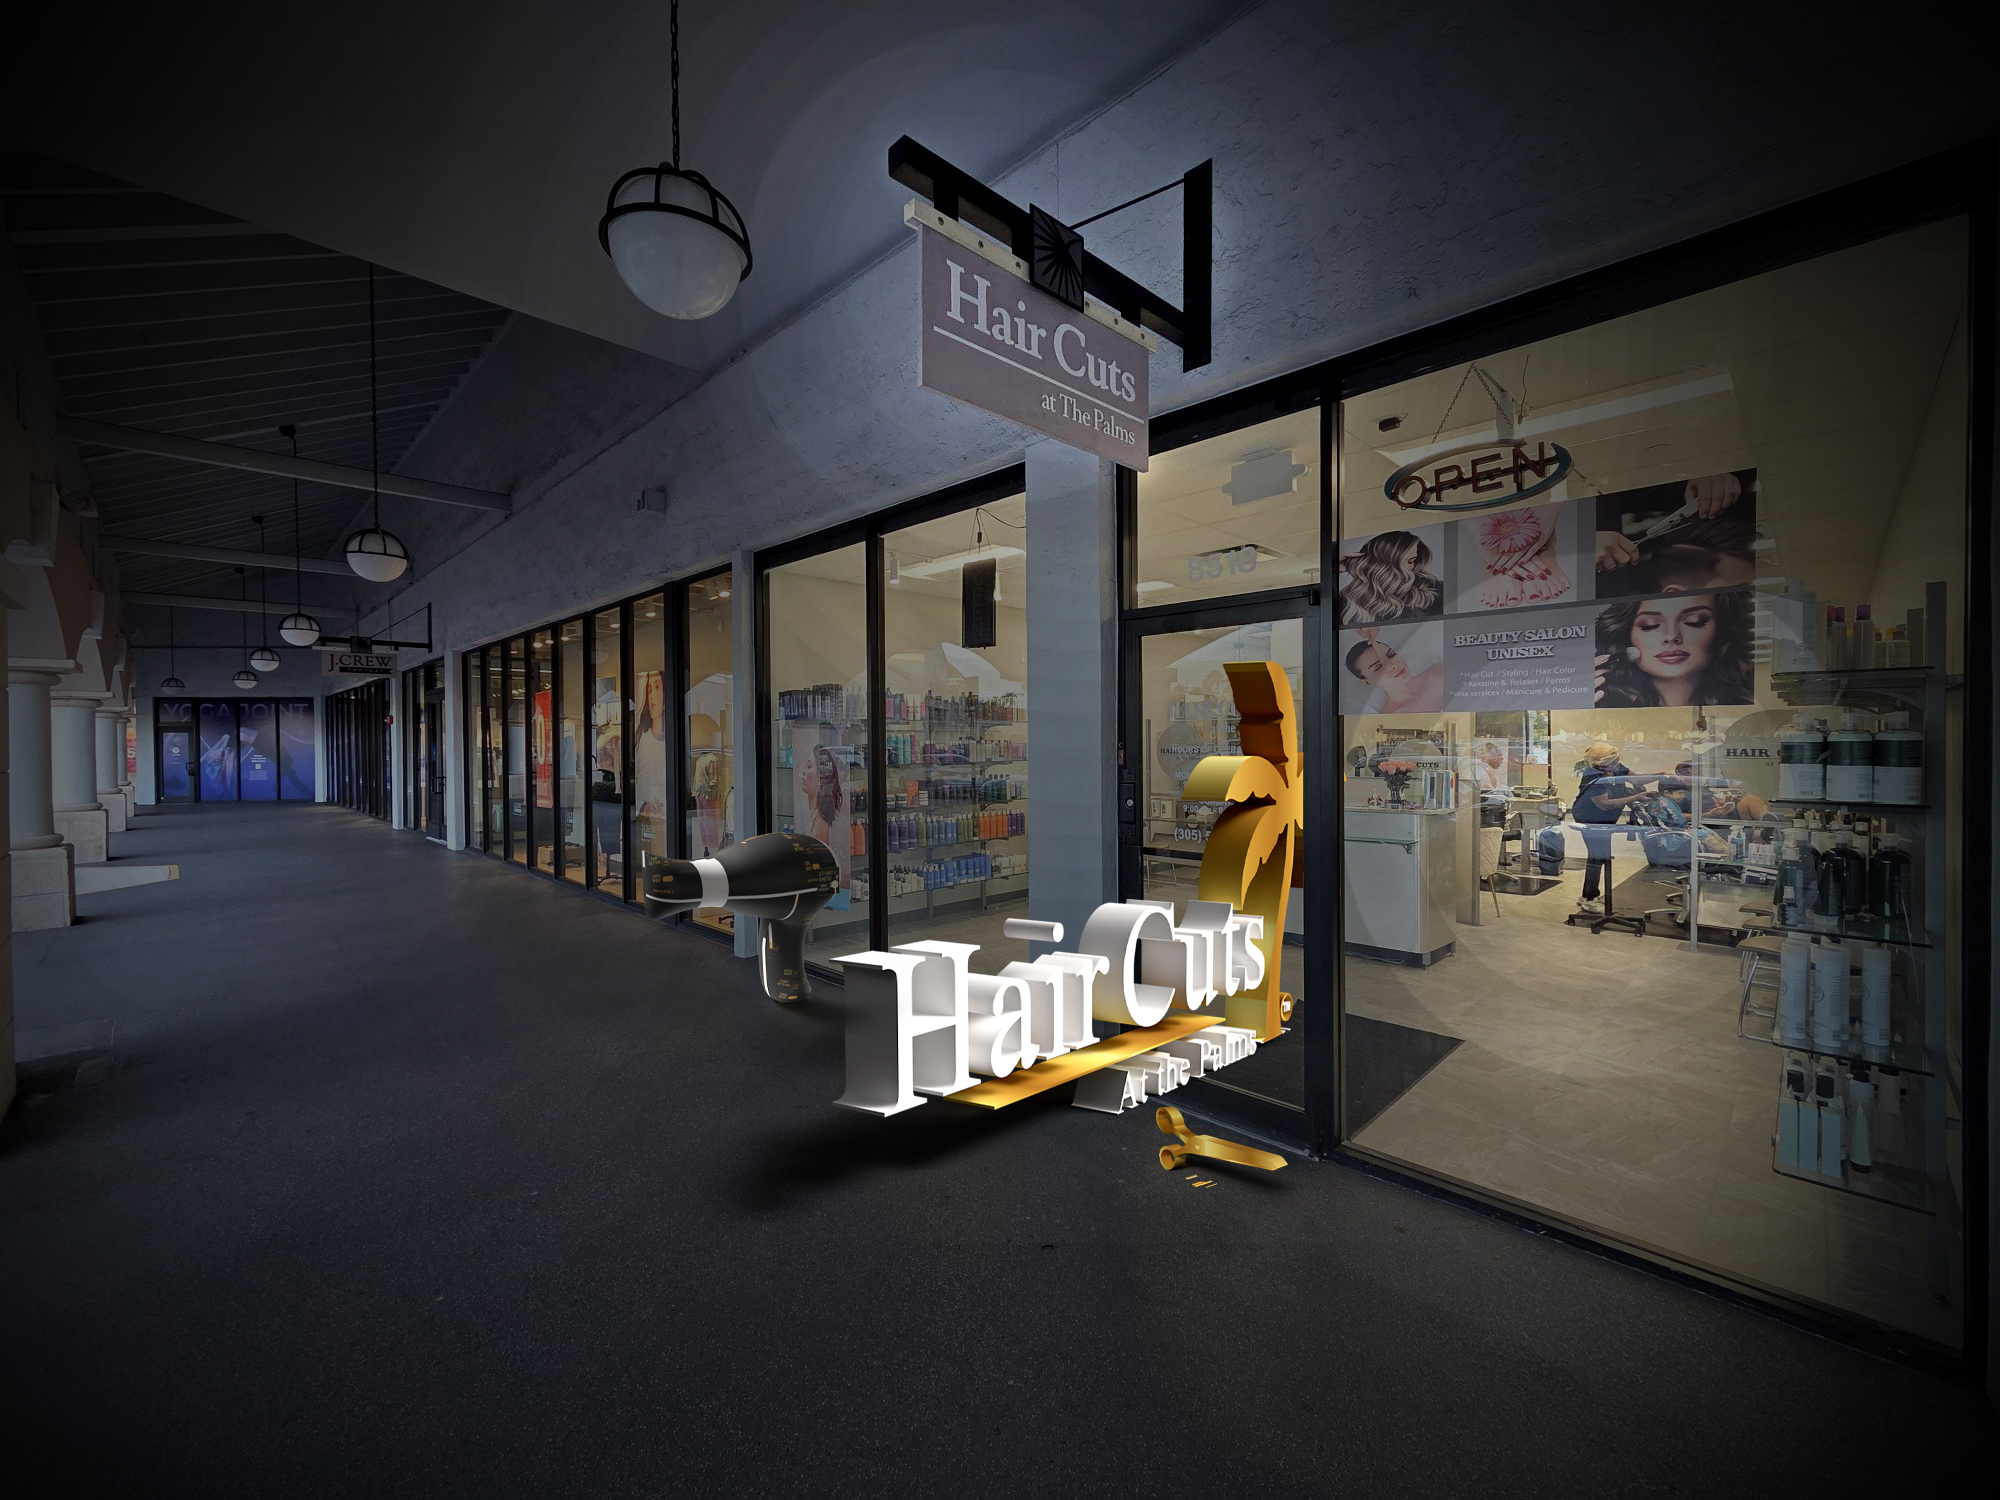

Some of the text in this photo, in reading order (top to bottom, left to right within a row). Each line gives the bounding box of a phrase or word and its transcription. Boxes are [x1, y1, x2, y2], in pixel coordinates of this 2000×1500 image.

[946, 258, 1136, 403] Hair Cuts
[1041, 393, 1136, 445] at The Palms
[1393, 442, 1546, 508] OPEN
[1454, 625, 1587, 647] BEAUTY SALON
[1486, 645, 1555, 661] UNISEX
[328, 654, 392, 672] J.CREW
[1480, 670, 1494, 678] Cut
[1502, 668, 1529, 678] Styling
[1535, 667, 1553, 675] Hair
[1554, 666, 1577, 674] Color
[1505, 687, 1543, 696] Manicure
[1552, 685, 1589, 694] Pedicure
[1510, 678, 1538, 686] Relaxer
[164, 703, 309, 721] YOGA JOINT
[1726, 748, 1770, 758] HAIR
[1174, 828, 1202, 844] (305)
[832, 899, 1266, 1118] Hair Cuts
